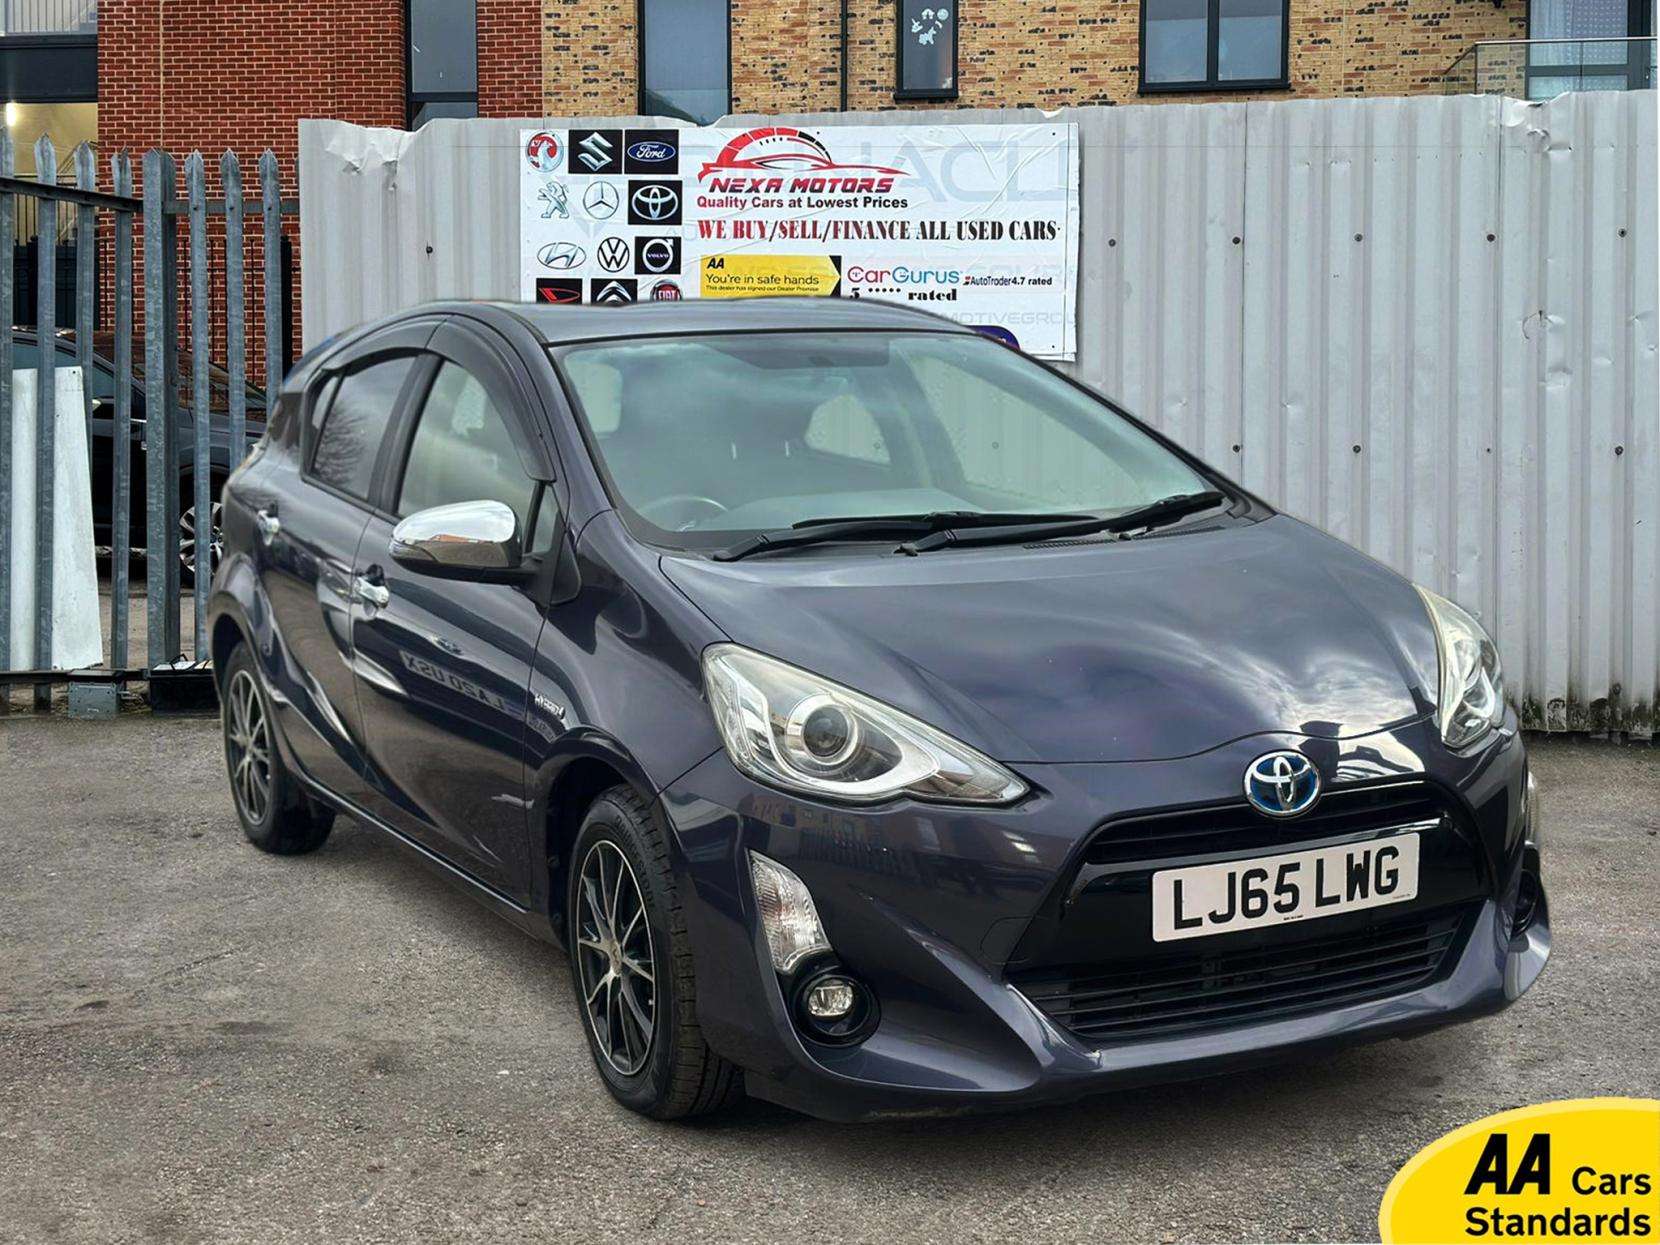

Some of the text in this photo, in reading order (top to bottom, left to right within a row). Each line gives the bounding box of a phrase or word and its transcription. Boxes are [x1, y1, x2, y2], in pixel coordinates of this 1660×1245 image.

[636, 144, 666, 159] Ford
[709, 178, 893, 193] NEXA MOTORS
[697, 196, 908, 210] Quality Cars at Lowest Prices
[698, 219, 727, 240] WE
[916, 220, 951, 240] ALL
[956, 220, 1004, 241] USED
[1008, 220, 1057, 241] CARS
[706, 257, 725, 269] AA
[705, 274, 819, 285] You're in safe hands
[847, 266, 960, 284] CarGurus
[1028, 277, 1053, 286] rated
[908, 288, 957, 301] rated
[1173, 845, 1400, 930] LJ65 LWG
